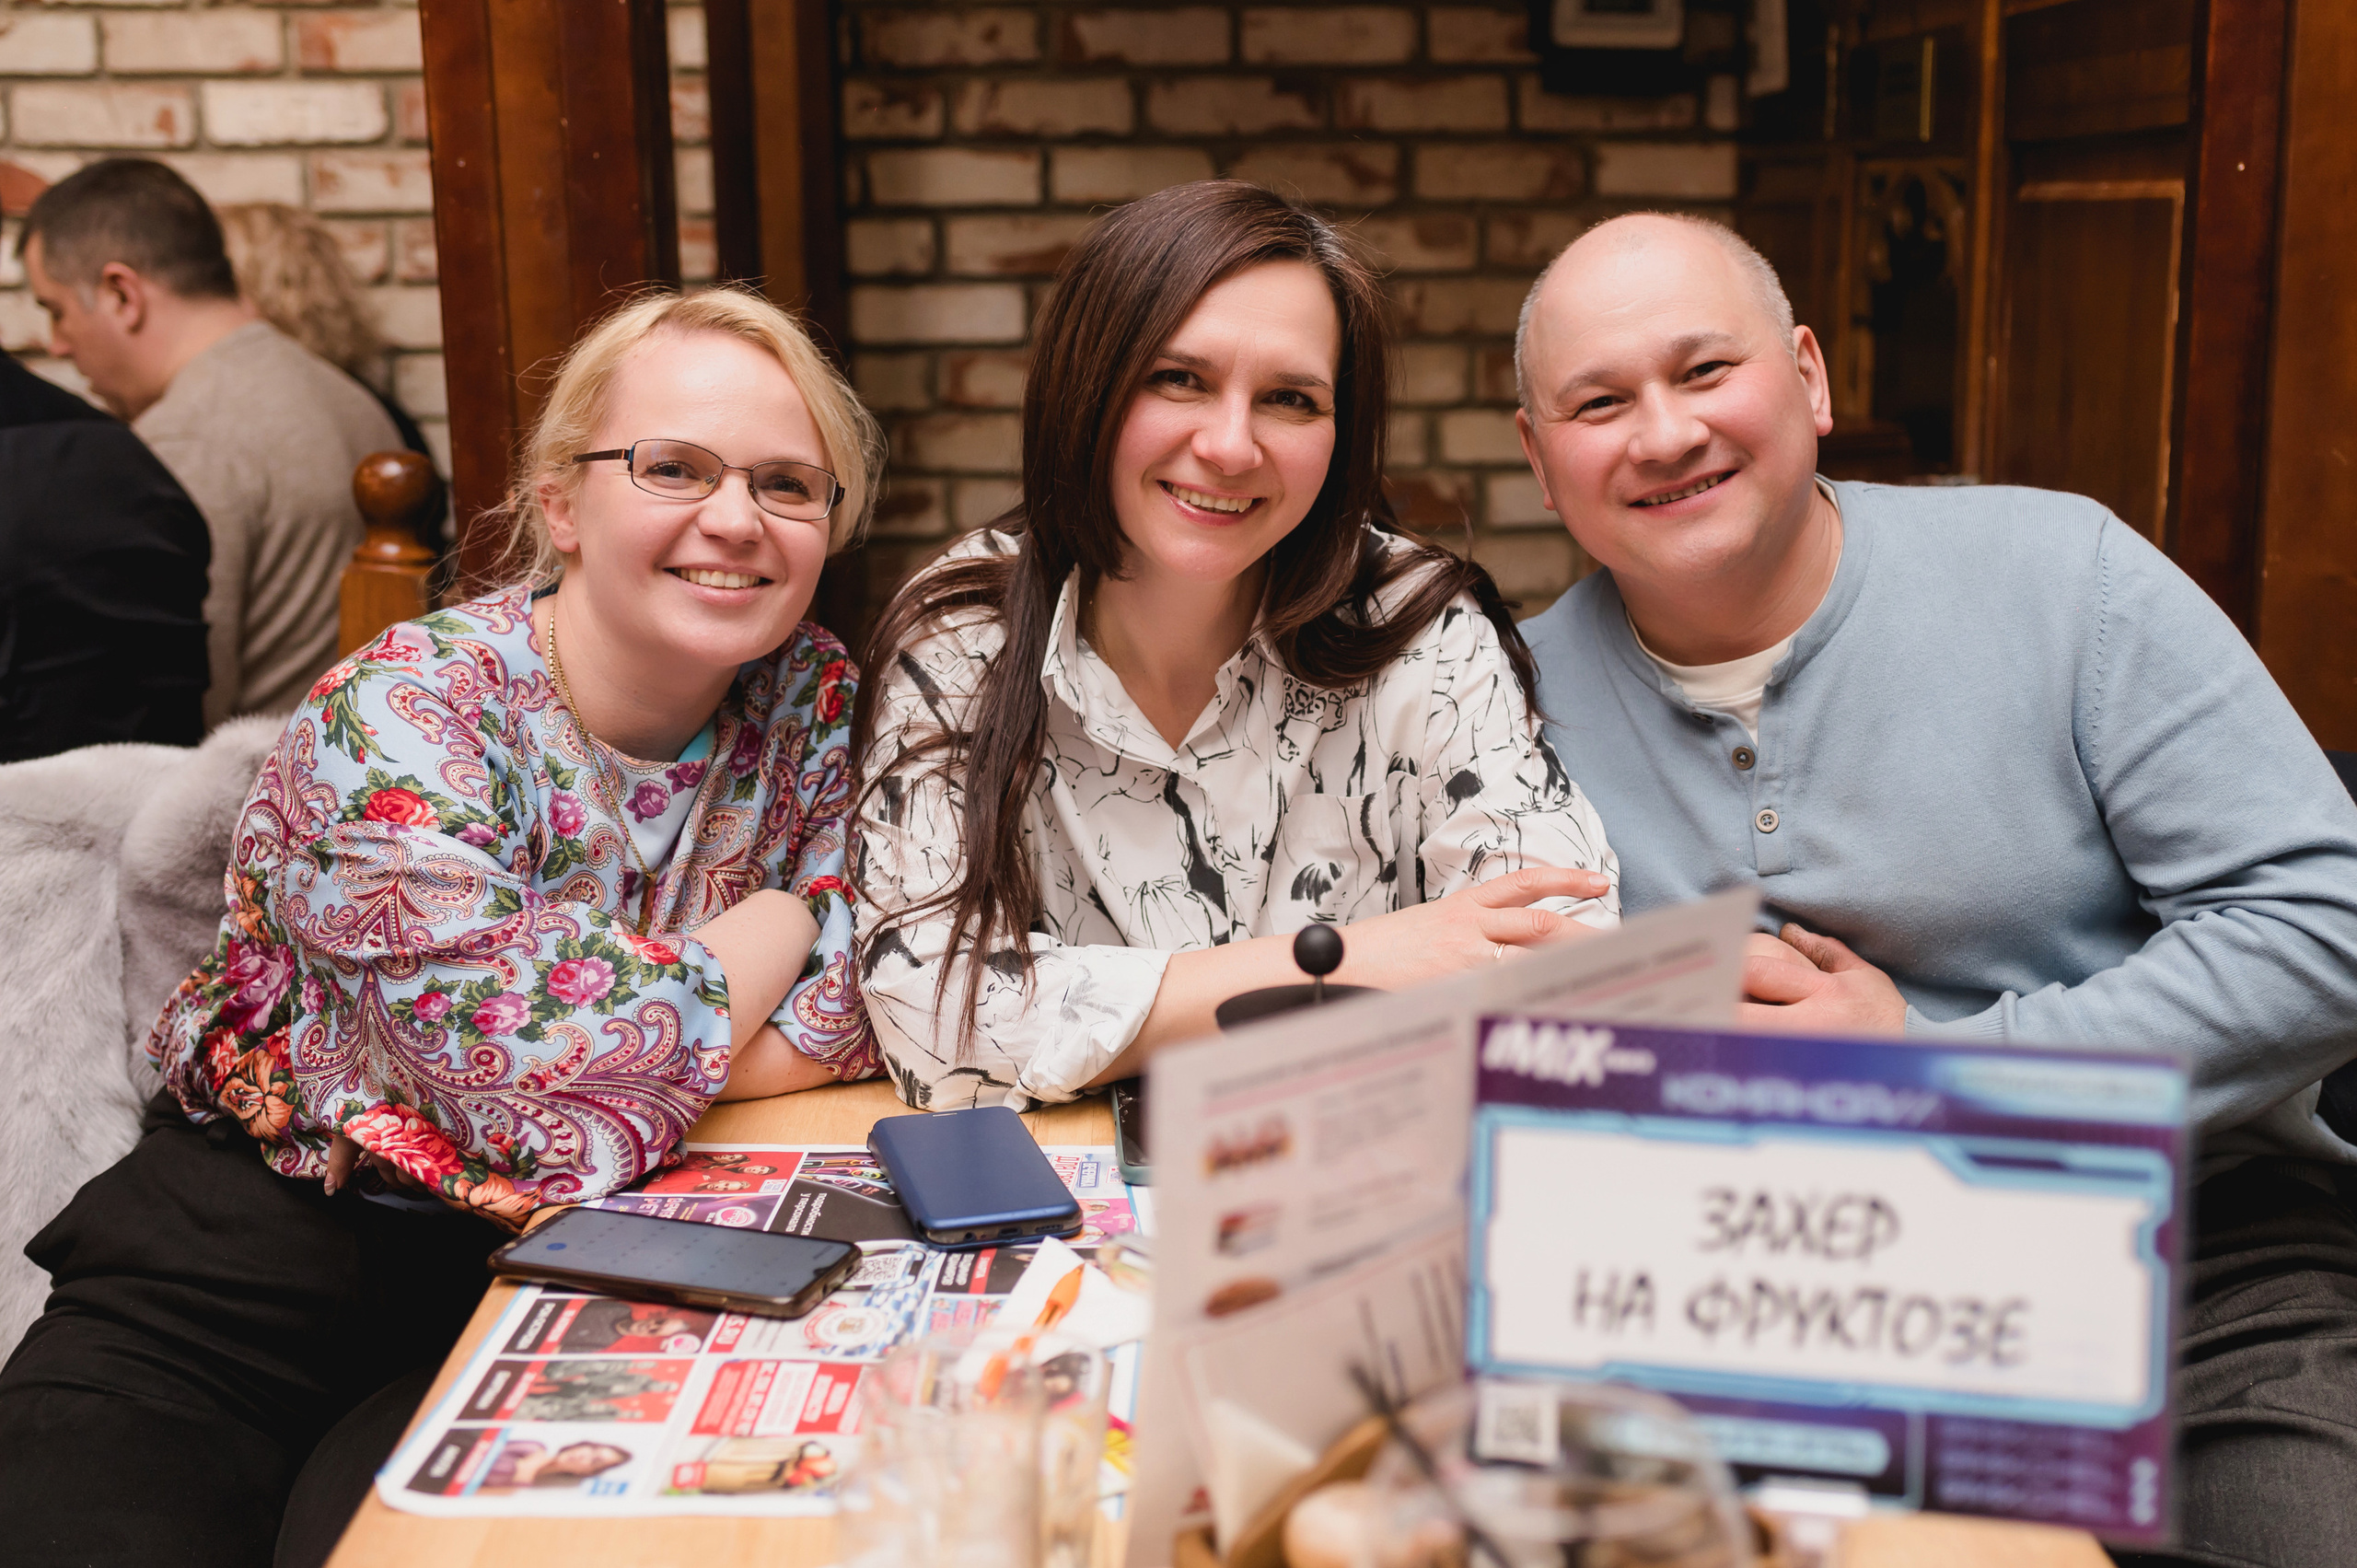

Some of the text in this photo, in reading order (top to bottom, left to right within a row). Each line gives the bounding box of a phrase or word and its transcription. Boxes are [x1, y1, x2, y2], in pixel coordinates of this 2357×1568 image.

[785, 1198, 808, 1233] персонала
[800, 1192, 828, 1236] подробности
[1696, 1186, 1903, 1267] ЗАХЕР
[1571, 1265, 2032, 1367] НА ФРУКТОЗЕ
